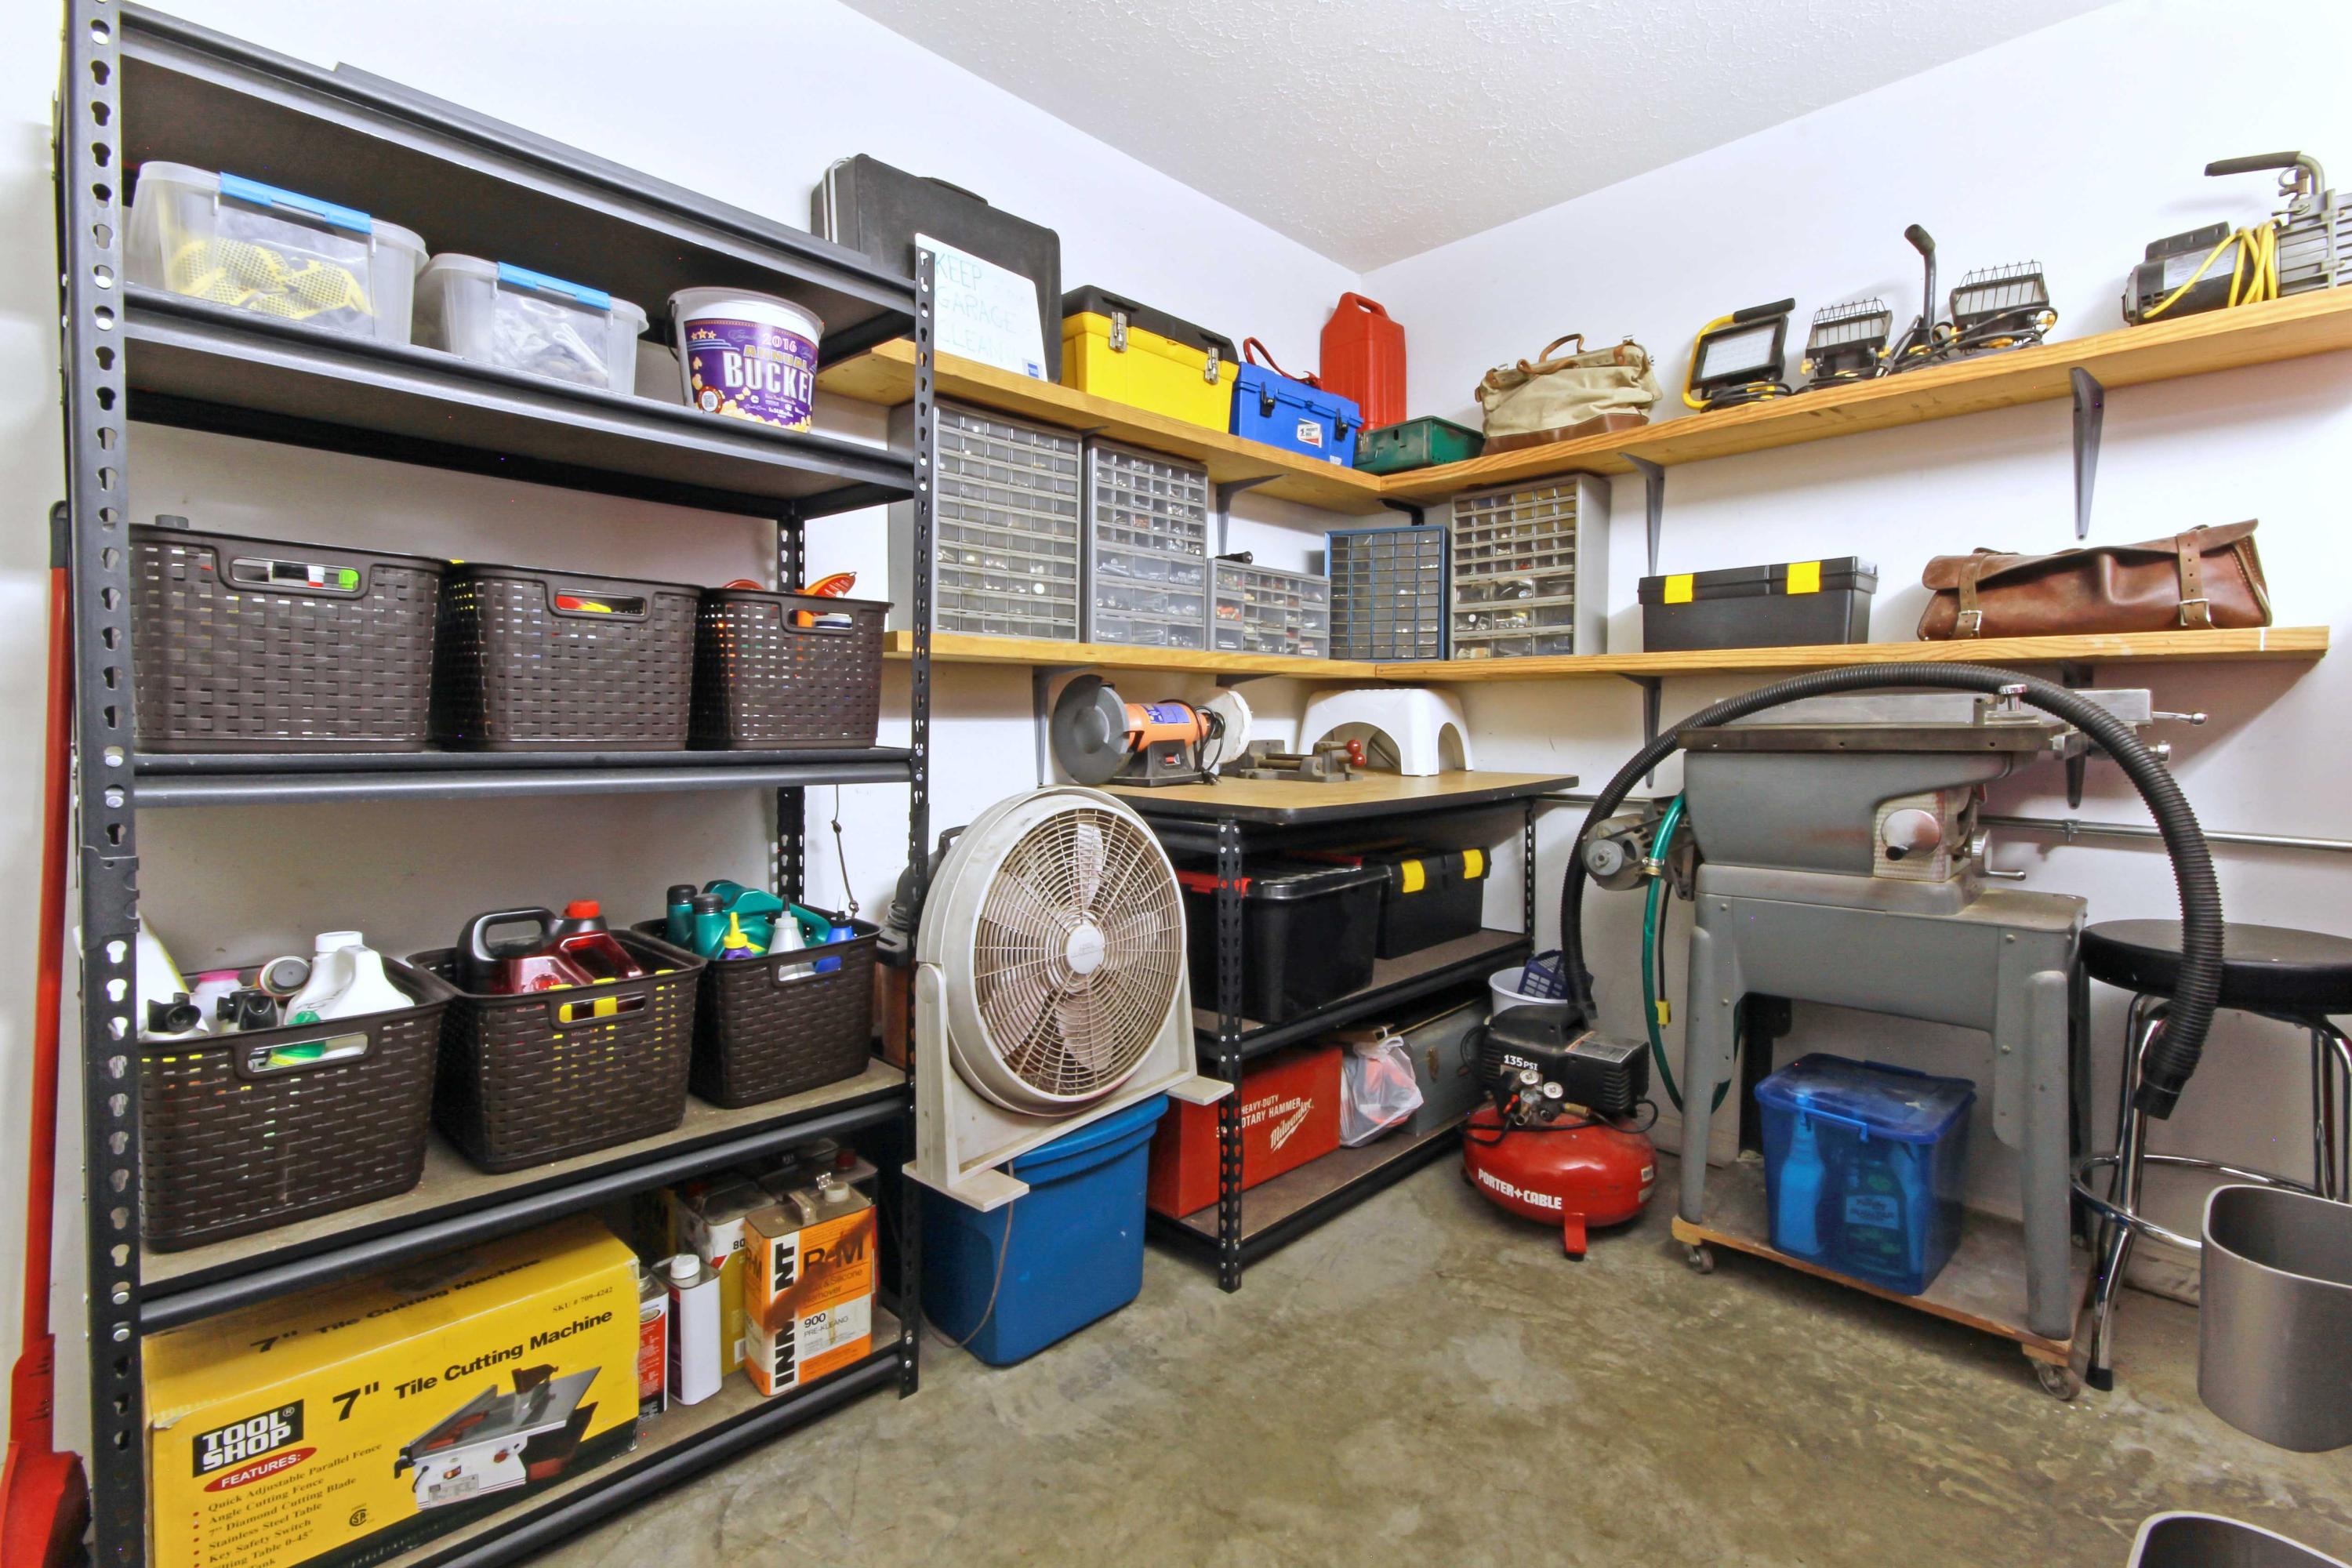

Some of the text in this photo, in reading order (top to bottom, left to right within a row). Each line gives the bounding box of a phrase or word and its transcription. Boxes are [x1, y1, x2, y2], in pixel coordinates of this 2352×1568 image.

[935, 252, 982, 291] KEEP
[935, 286, 1017, 334] GARAGE
[743, 344, 808, 372] ANNUAL
[761, 332, 797, 353] 2016
[1504, 1054, 1538, 1072] 135 PSI
[1241, 1094, 1279, 1115] HEAVY-DUTY
[1241, 1097, 1301, 1129] OTARY HAMMER
[1270, 1098, 1312, 1150] Milwaukee
[314, 1318, 361, 1334] Tile
[365, 1289, 451, 1319] Cutting
[455, 1259, 541, 1290] Machine
[830, 1269, 863, 1286] Silicone
[552, 1301, 572, 1313] SKU
[804, 1312, 826, 1328] 900
[332, 1311, 613, 1423] 7" Tile Cutting Machine
[202, 1410, 288, 1452] TOOL
[203, 1424, 292, 1472] SHOP
[208, 1443, 383, 1512] Quick Adjustable Parallel Fence
[221, 1453, 302, 1489] FEATURES:
[209, 1477, 325, 1525] Angle Cutting Fence
[226, 1506, 278, 1531] Diamond
[281, 1491, 324, 1511] Cutting
[327, 1476, 357, 1493] Blade
[208, 1503, 323, 1550] Stainless Steel Table
[209, 1520, 311, 1564] Key Safety Switch
[252, 1542, 282, 1559] Table
